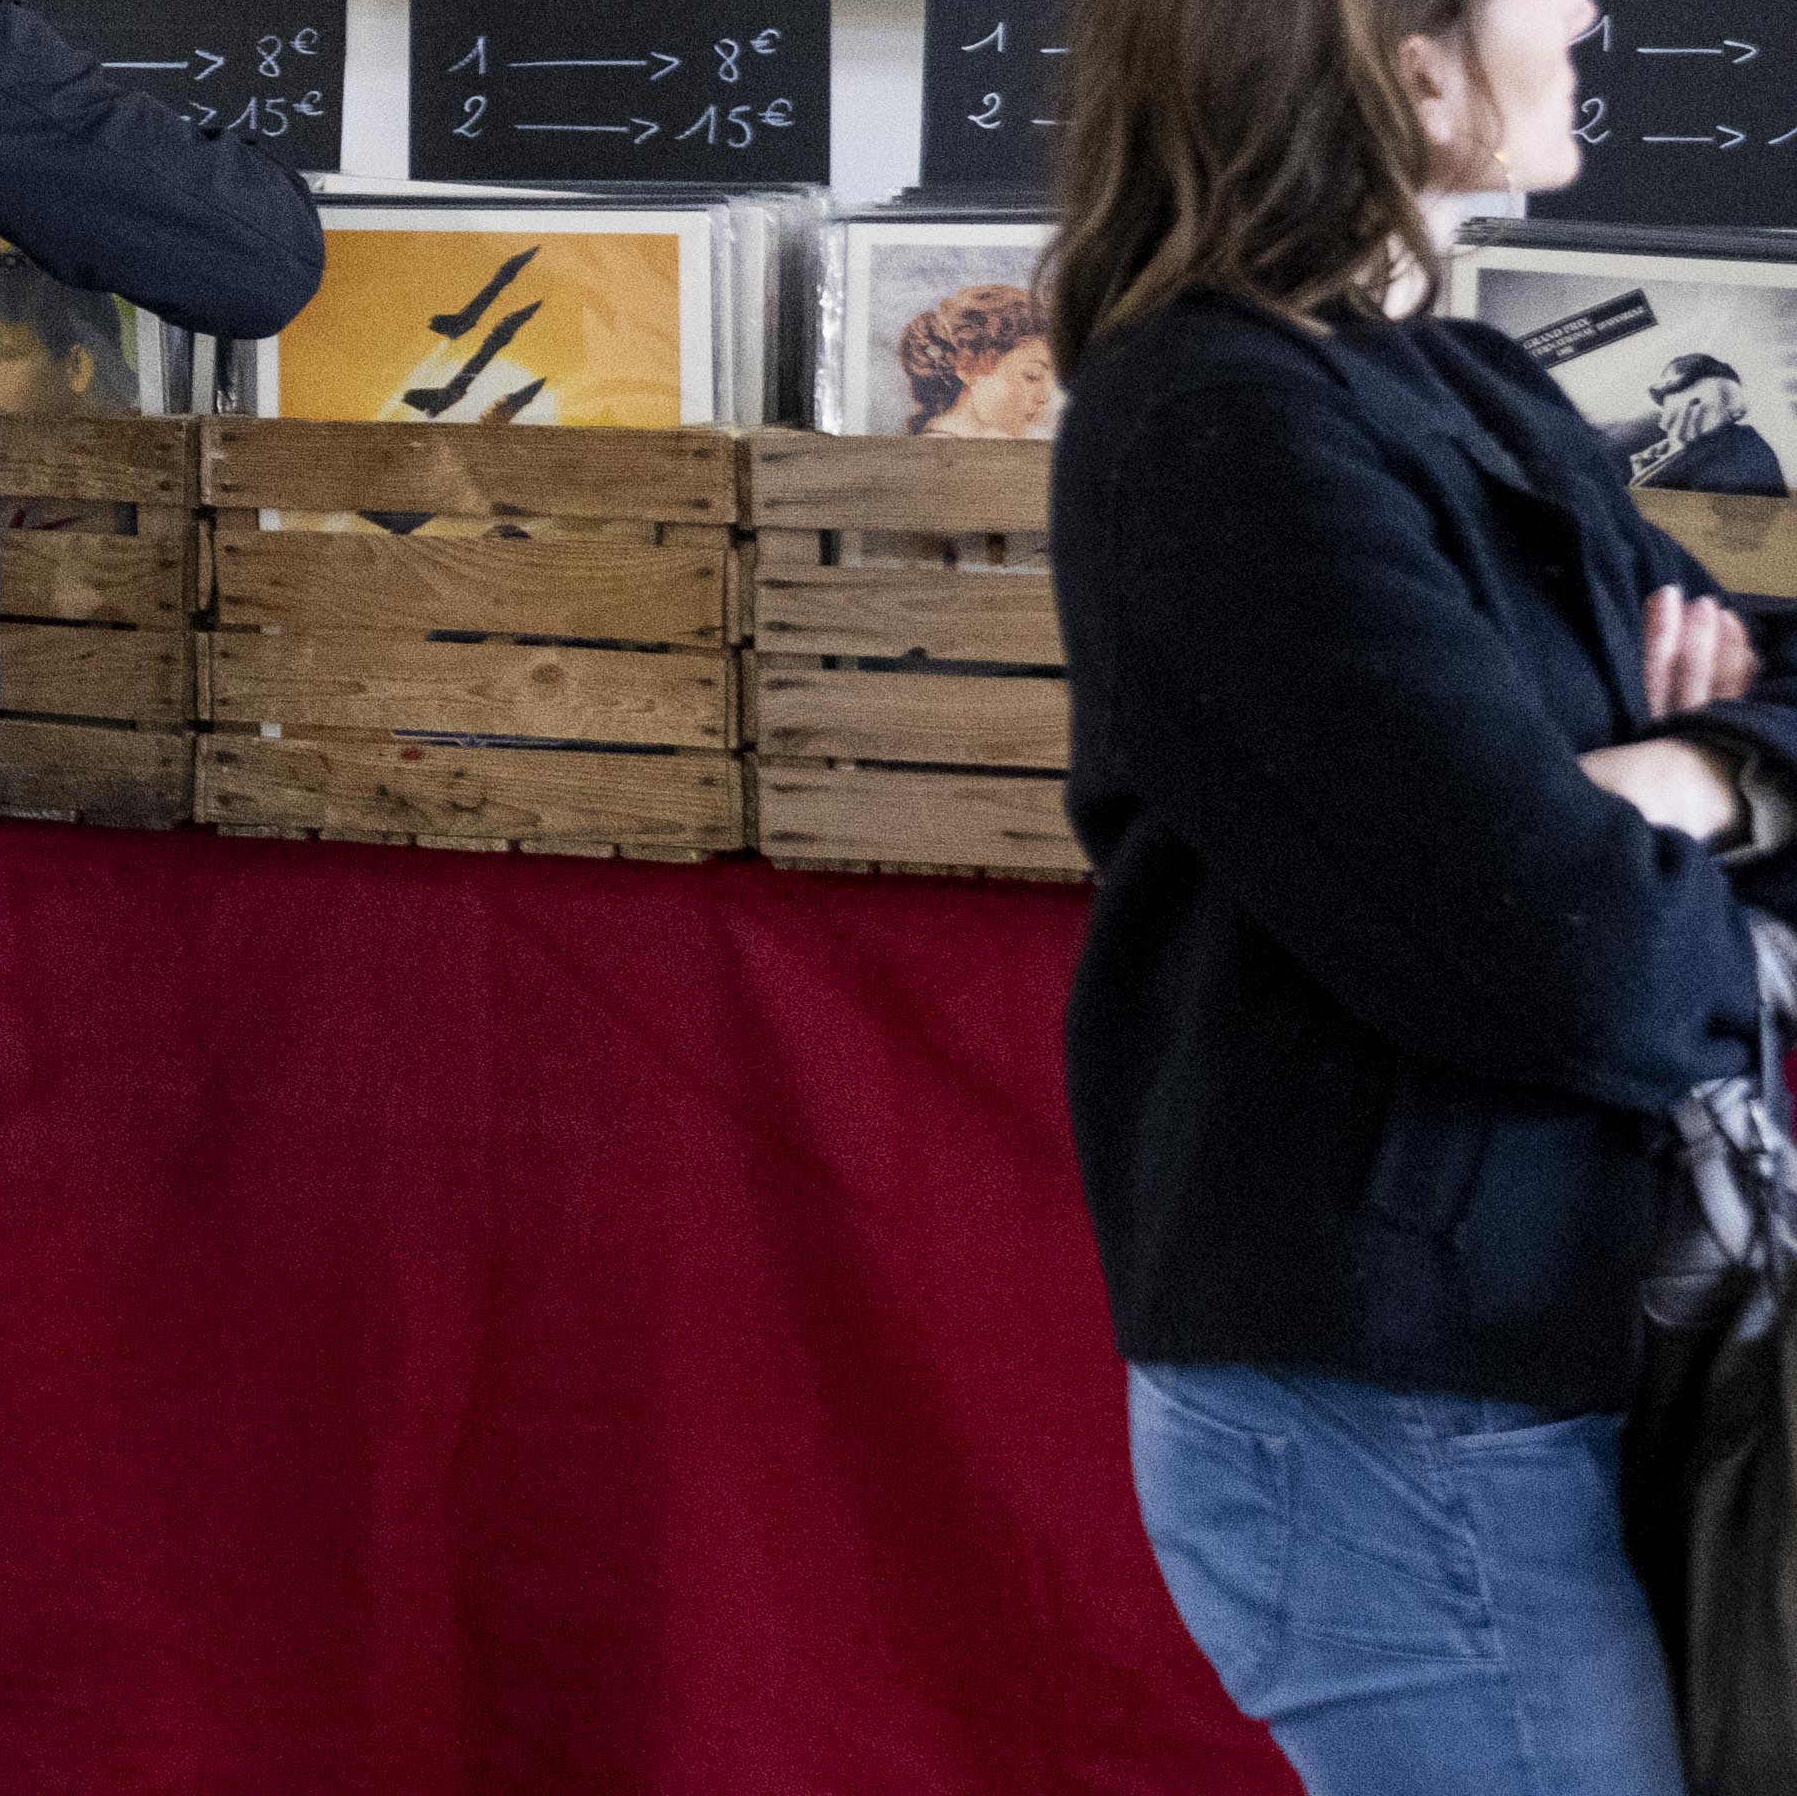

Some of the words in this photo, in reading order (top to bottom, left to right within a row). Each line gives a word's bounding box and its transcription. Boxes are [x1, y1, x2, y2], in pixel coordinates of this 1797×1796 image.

[447, 36, 488, 76] 1
[453, 94, 488, 140] 2
[966, 92, 1004, 131] 2
